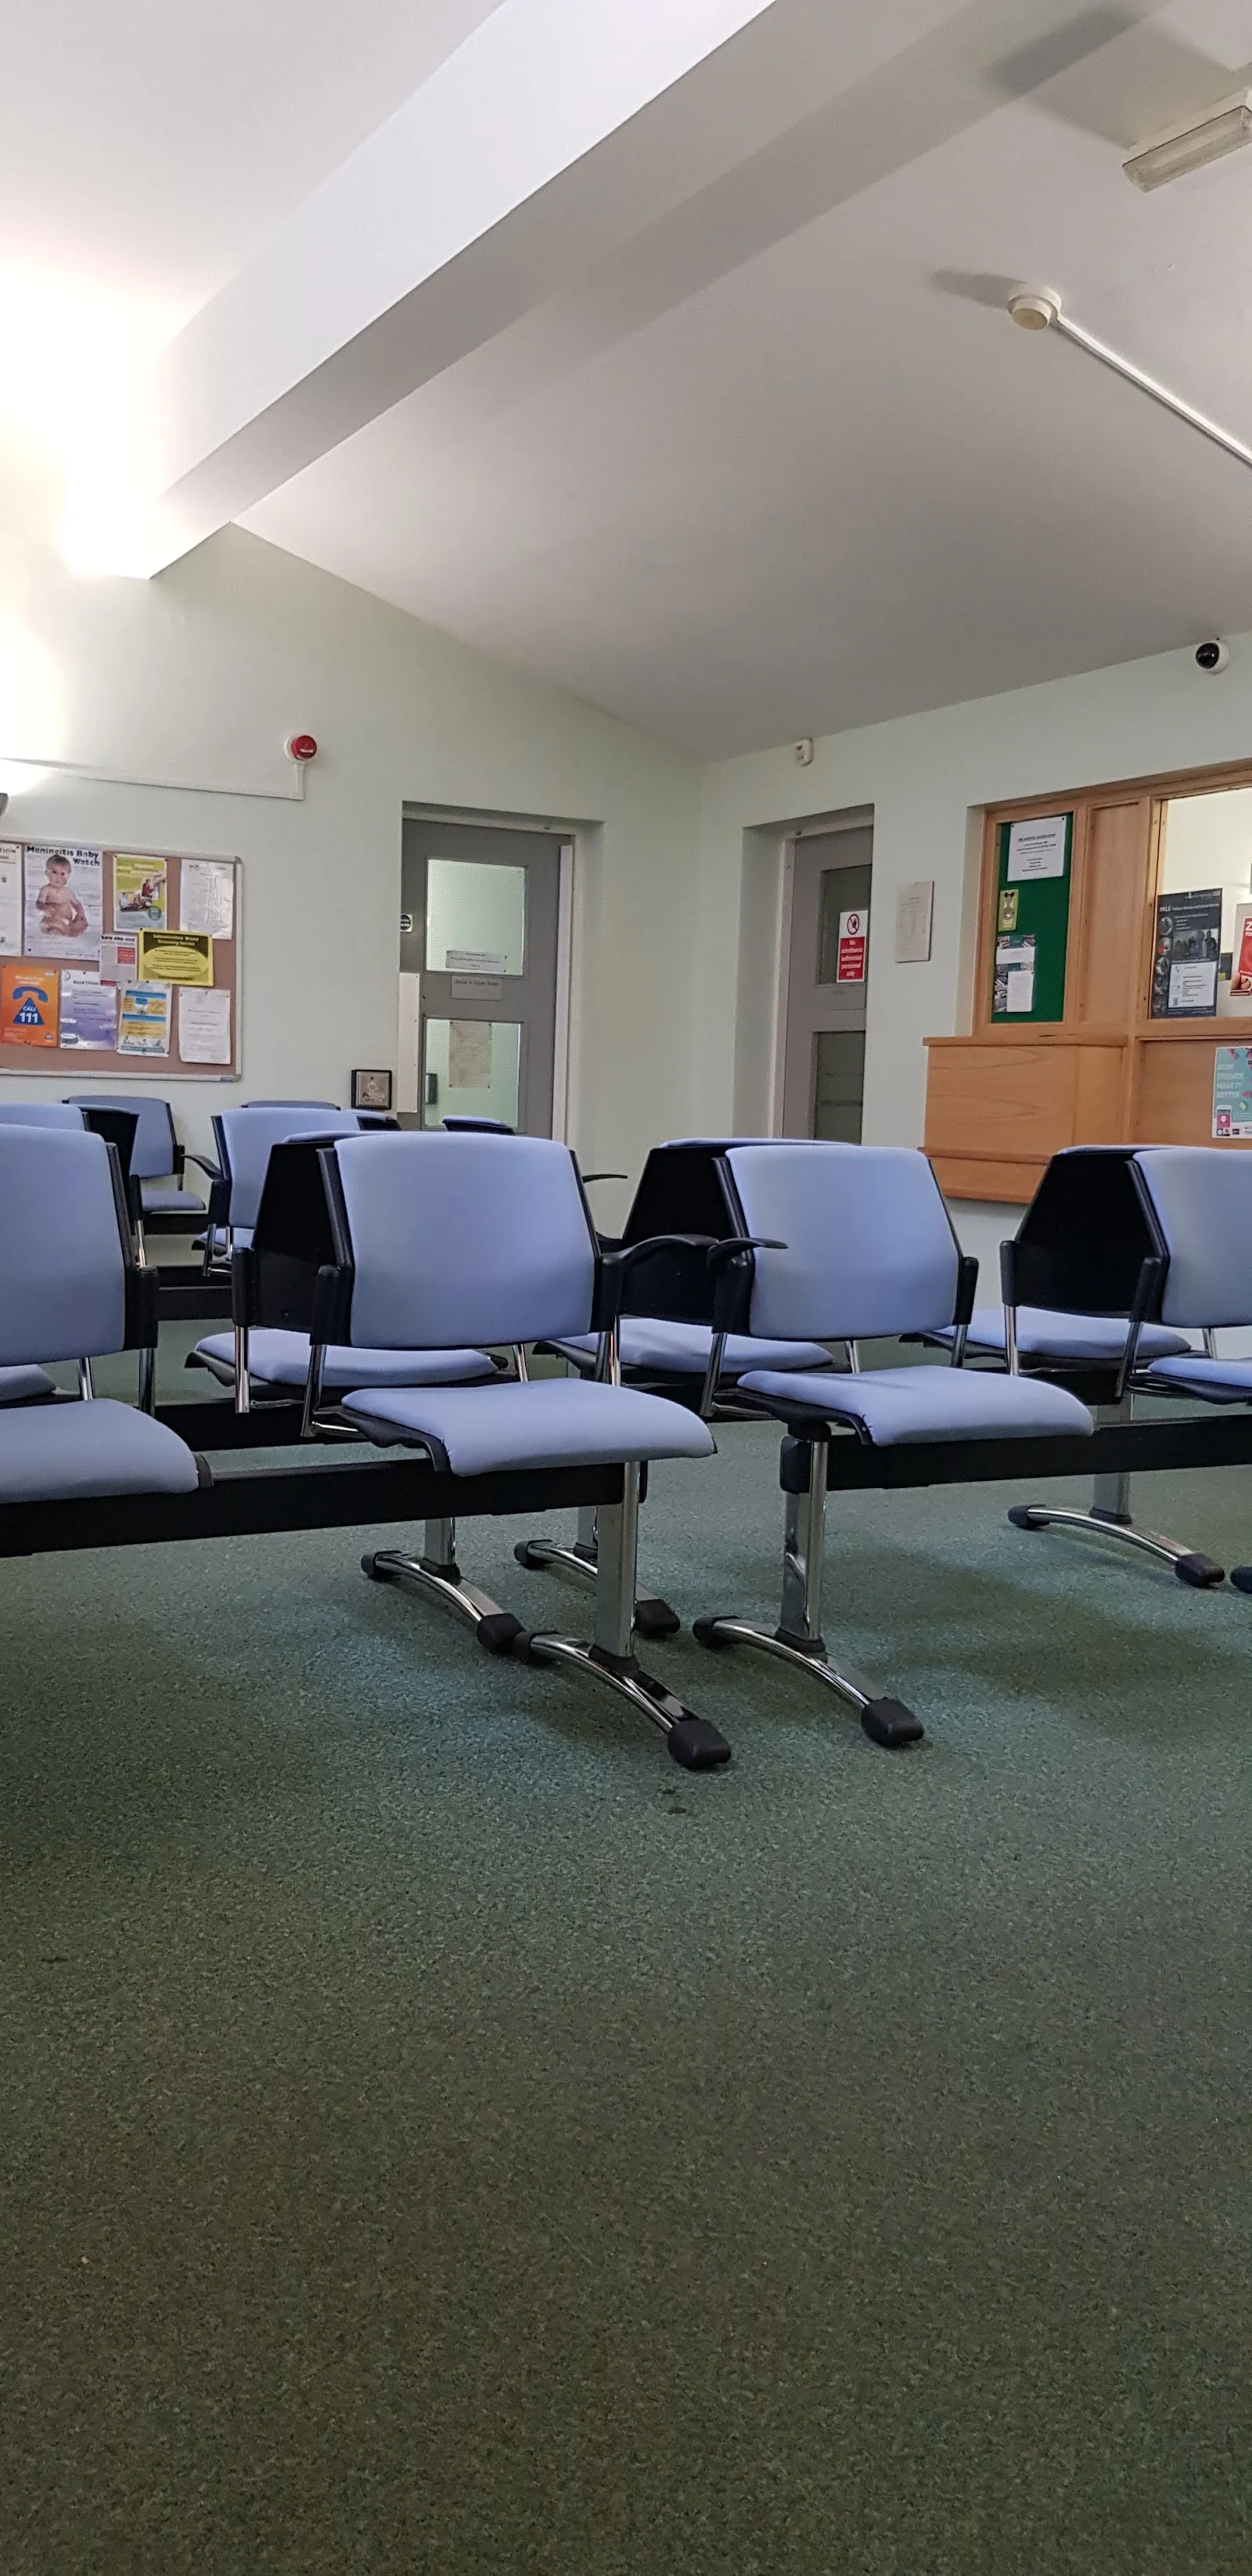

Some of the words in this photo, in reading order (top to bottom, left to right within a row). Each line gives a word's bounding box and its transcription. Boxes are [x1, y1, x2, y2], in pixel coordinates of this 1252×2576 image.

[27, 846, 74, 856] Meningitis
[77, 850, 99, 859] Baby
[73, 858, 99, 866] Watch
[20, 1012, 38, 1023] 111
